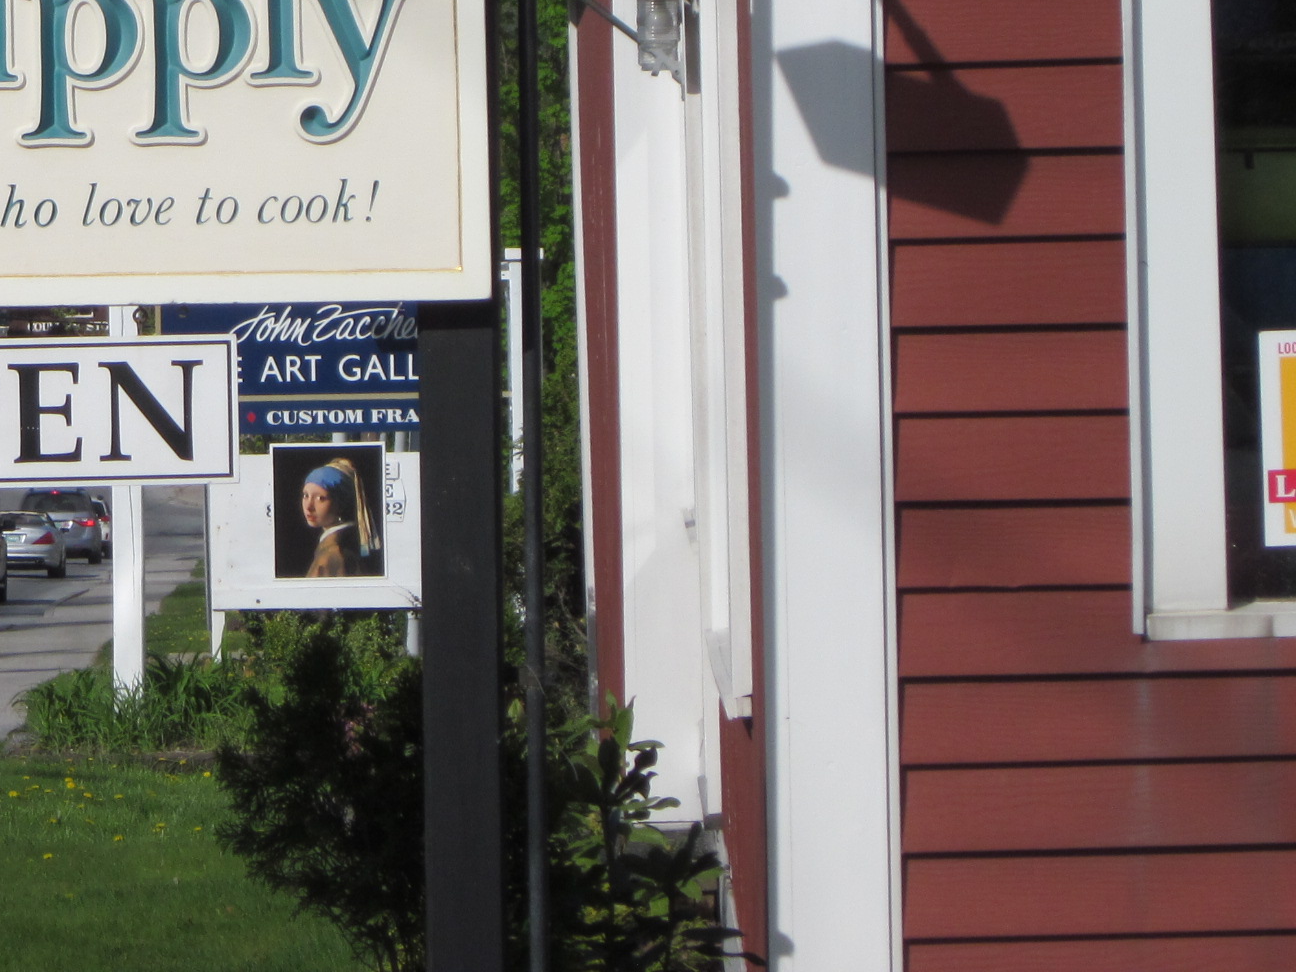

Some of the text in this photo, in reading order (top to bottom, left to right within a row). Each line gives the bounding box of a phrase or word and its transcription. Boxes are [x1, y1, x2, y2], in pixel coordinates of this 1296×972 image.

[81, 182, 176, 226] love
[195, 187, 240, 225] to
[257, 178, 380, 225] cook!
[229, 305, 312, 346] John
[260, 354, 322, 382] ART
[338, 353, 419, 382] GALL
[266, 409, 364, 425] CUSTOM
